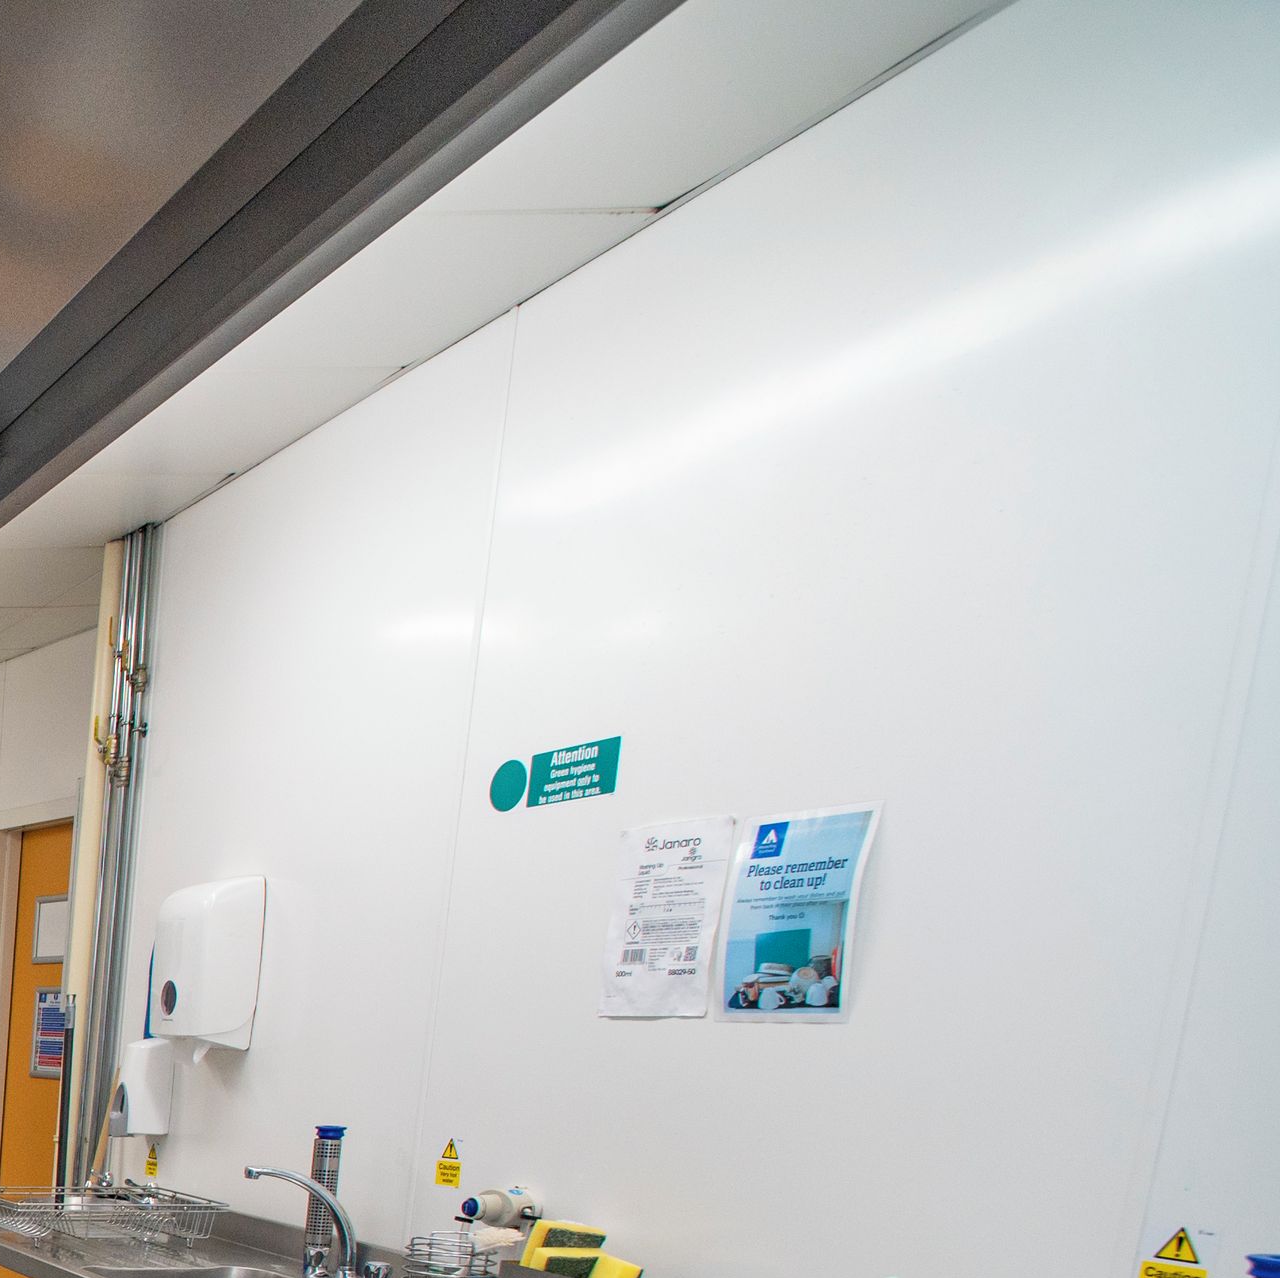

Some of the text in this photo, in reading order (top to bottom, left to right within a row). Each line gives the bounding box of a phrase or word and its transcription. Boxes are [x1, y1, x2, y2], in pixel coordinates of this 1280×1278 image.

[550, 745, 599, 767] Attention
[550, 763, 596, 779] Green hygiene
[543, 774, 600, 792] equipment only to
[538, 795, 546, 804] be
[548, 792, 563, 803] used
[564, 791, 570, 800] in
[571, 788, 583, 798] this
[747, 857, 848, 878] Please remember
[760, 873, 827, 891] to clean up!
[439, 1163, 460, 1171] Caution
